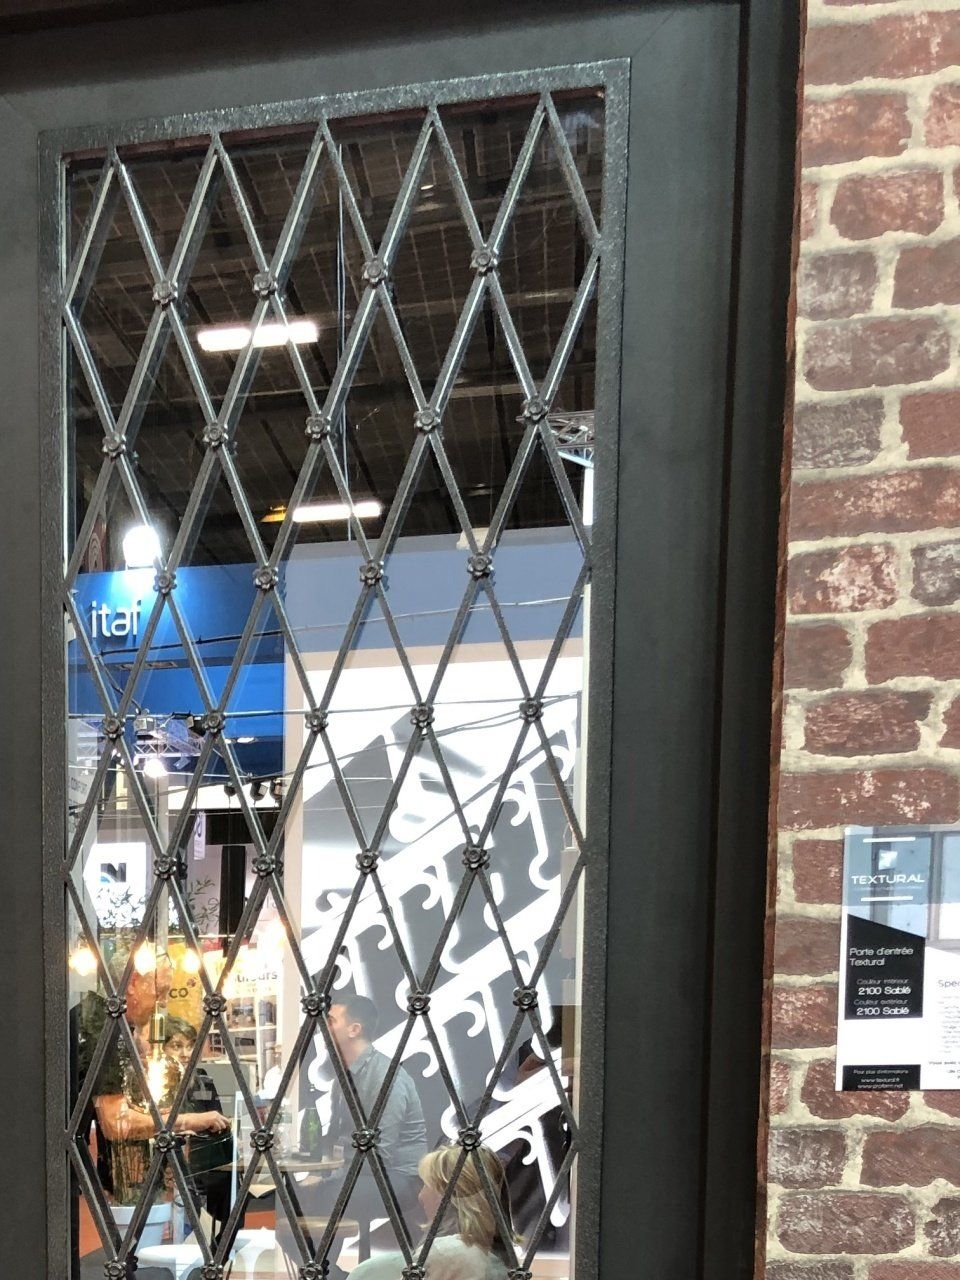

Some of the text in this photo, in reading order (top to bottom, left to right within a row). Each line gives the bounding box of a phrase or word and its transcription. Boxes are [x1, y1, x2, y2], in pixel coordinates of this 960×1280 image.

[851, 873, 926, 885] TEXTURAL
[849, 947, 874, 956] Porte
[849, 957, 886, 967] Textural
[858, 985, 912, 996] 2100 Sablé
[856, 1006, 910, 1016] 2100 Sablé
